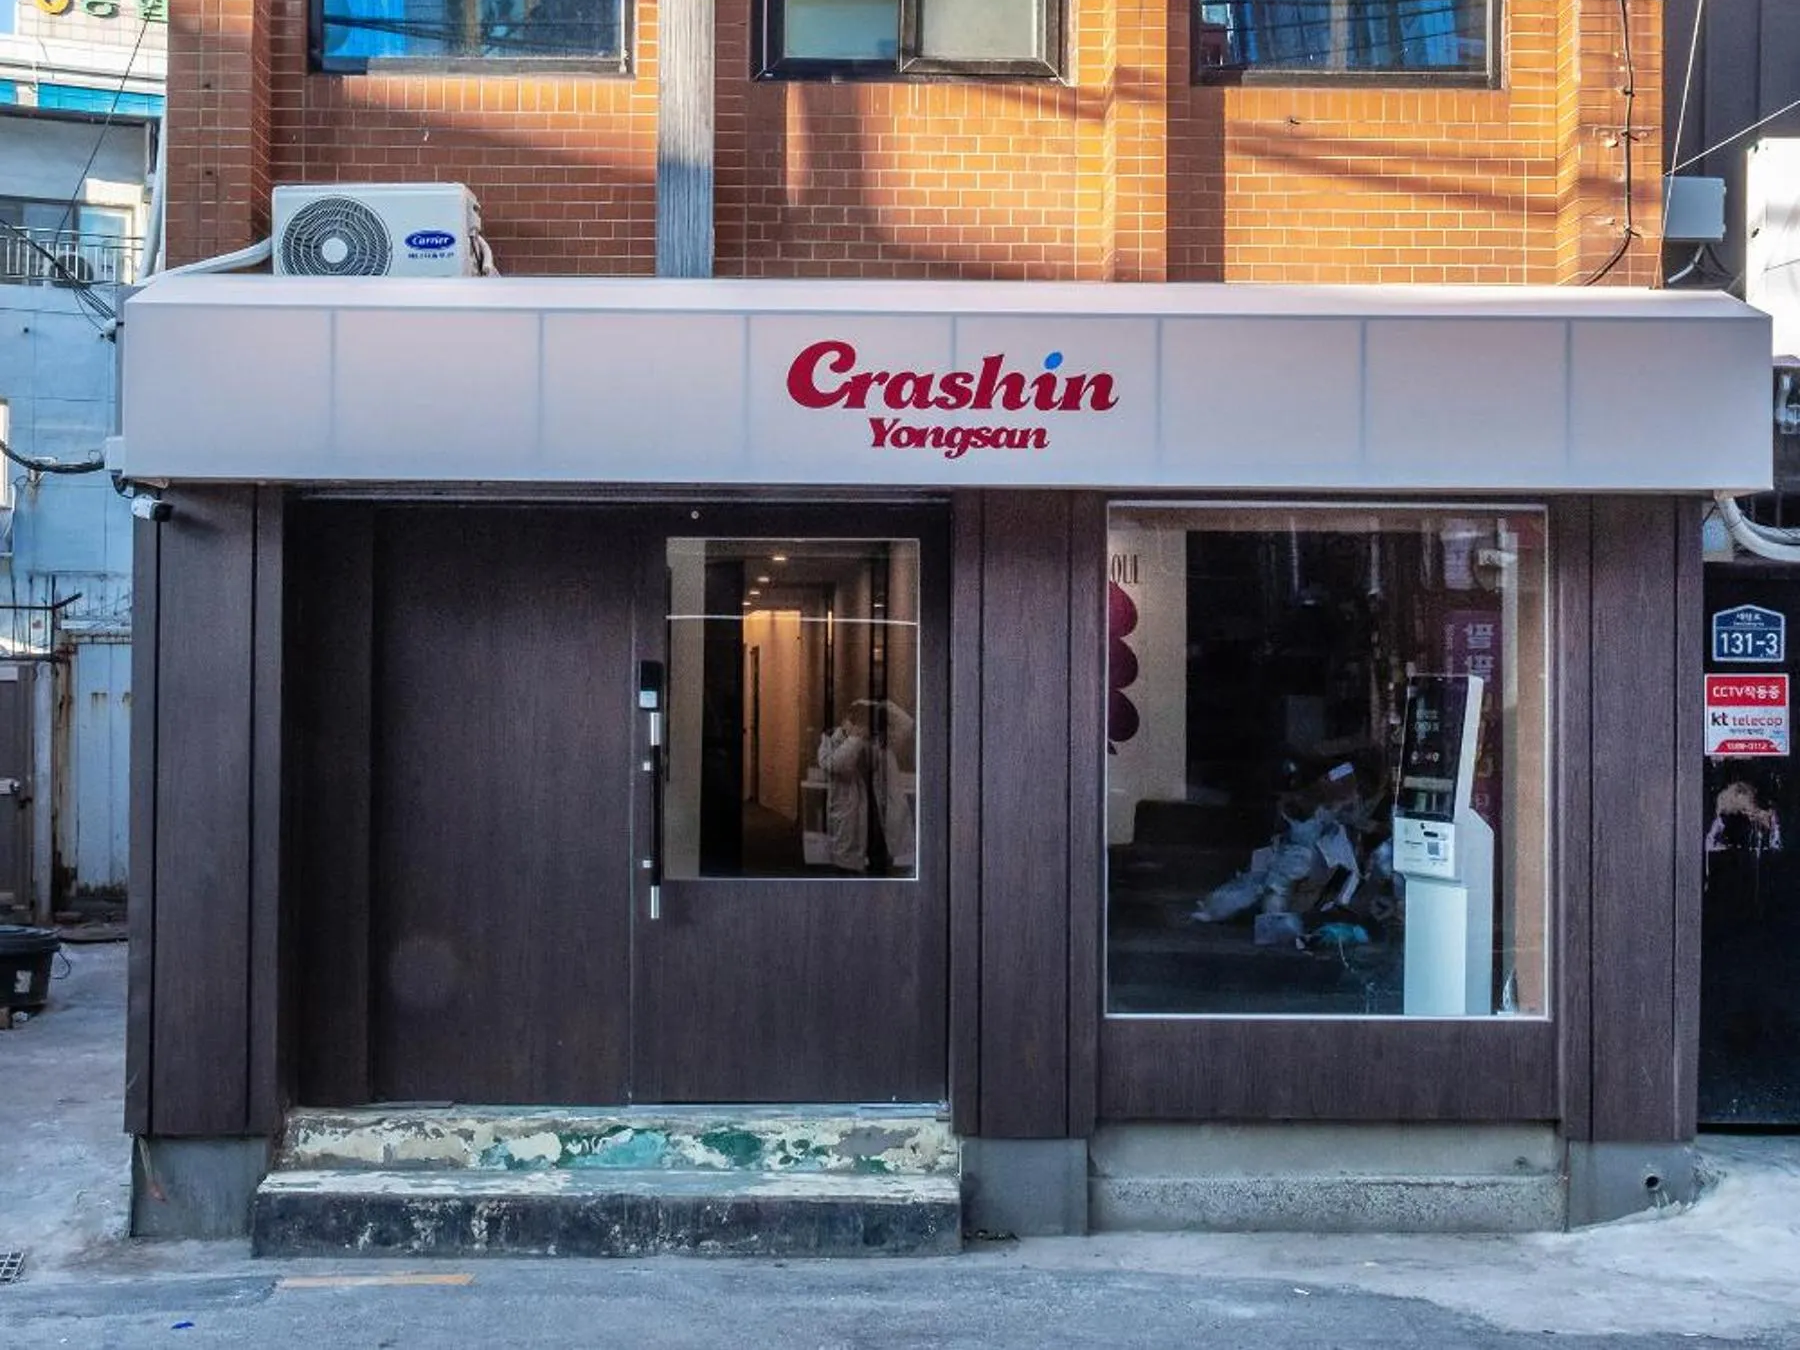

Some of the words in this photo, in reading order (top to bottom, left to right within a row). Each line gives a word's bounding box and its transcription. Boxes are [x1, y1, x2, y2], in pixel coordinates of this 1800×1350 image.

[787, 340, 1120, 412] Crashin
[868, 417, 1050, 460] Yongsan
[1720, 632, 1778, 655] 131-3
[1711, 712, 1729, 726] kt
[1733, 714, 1783, 728] telecop
